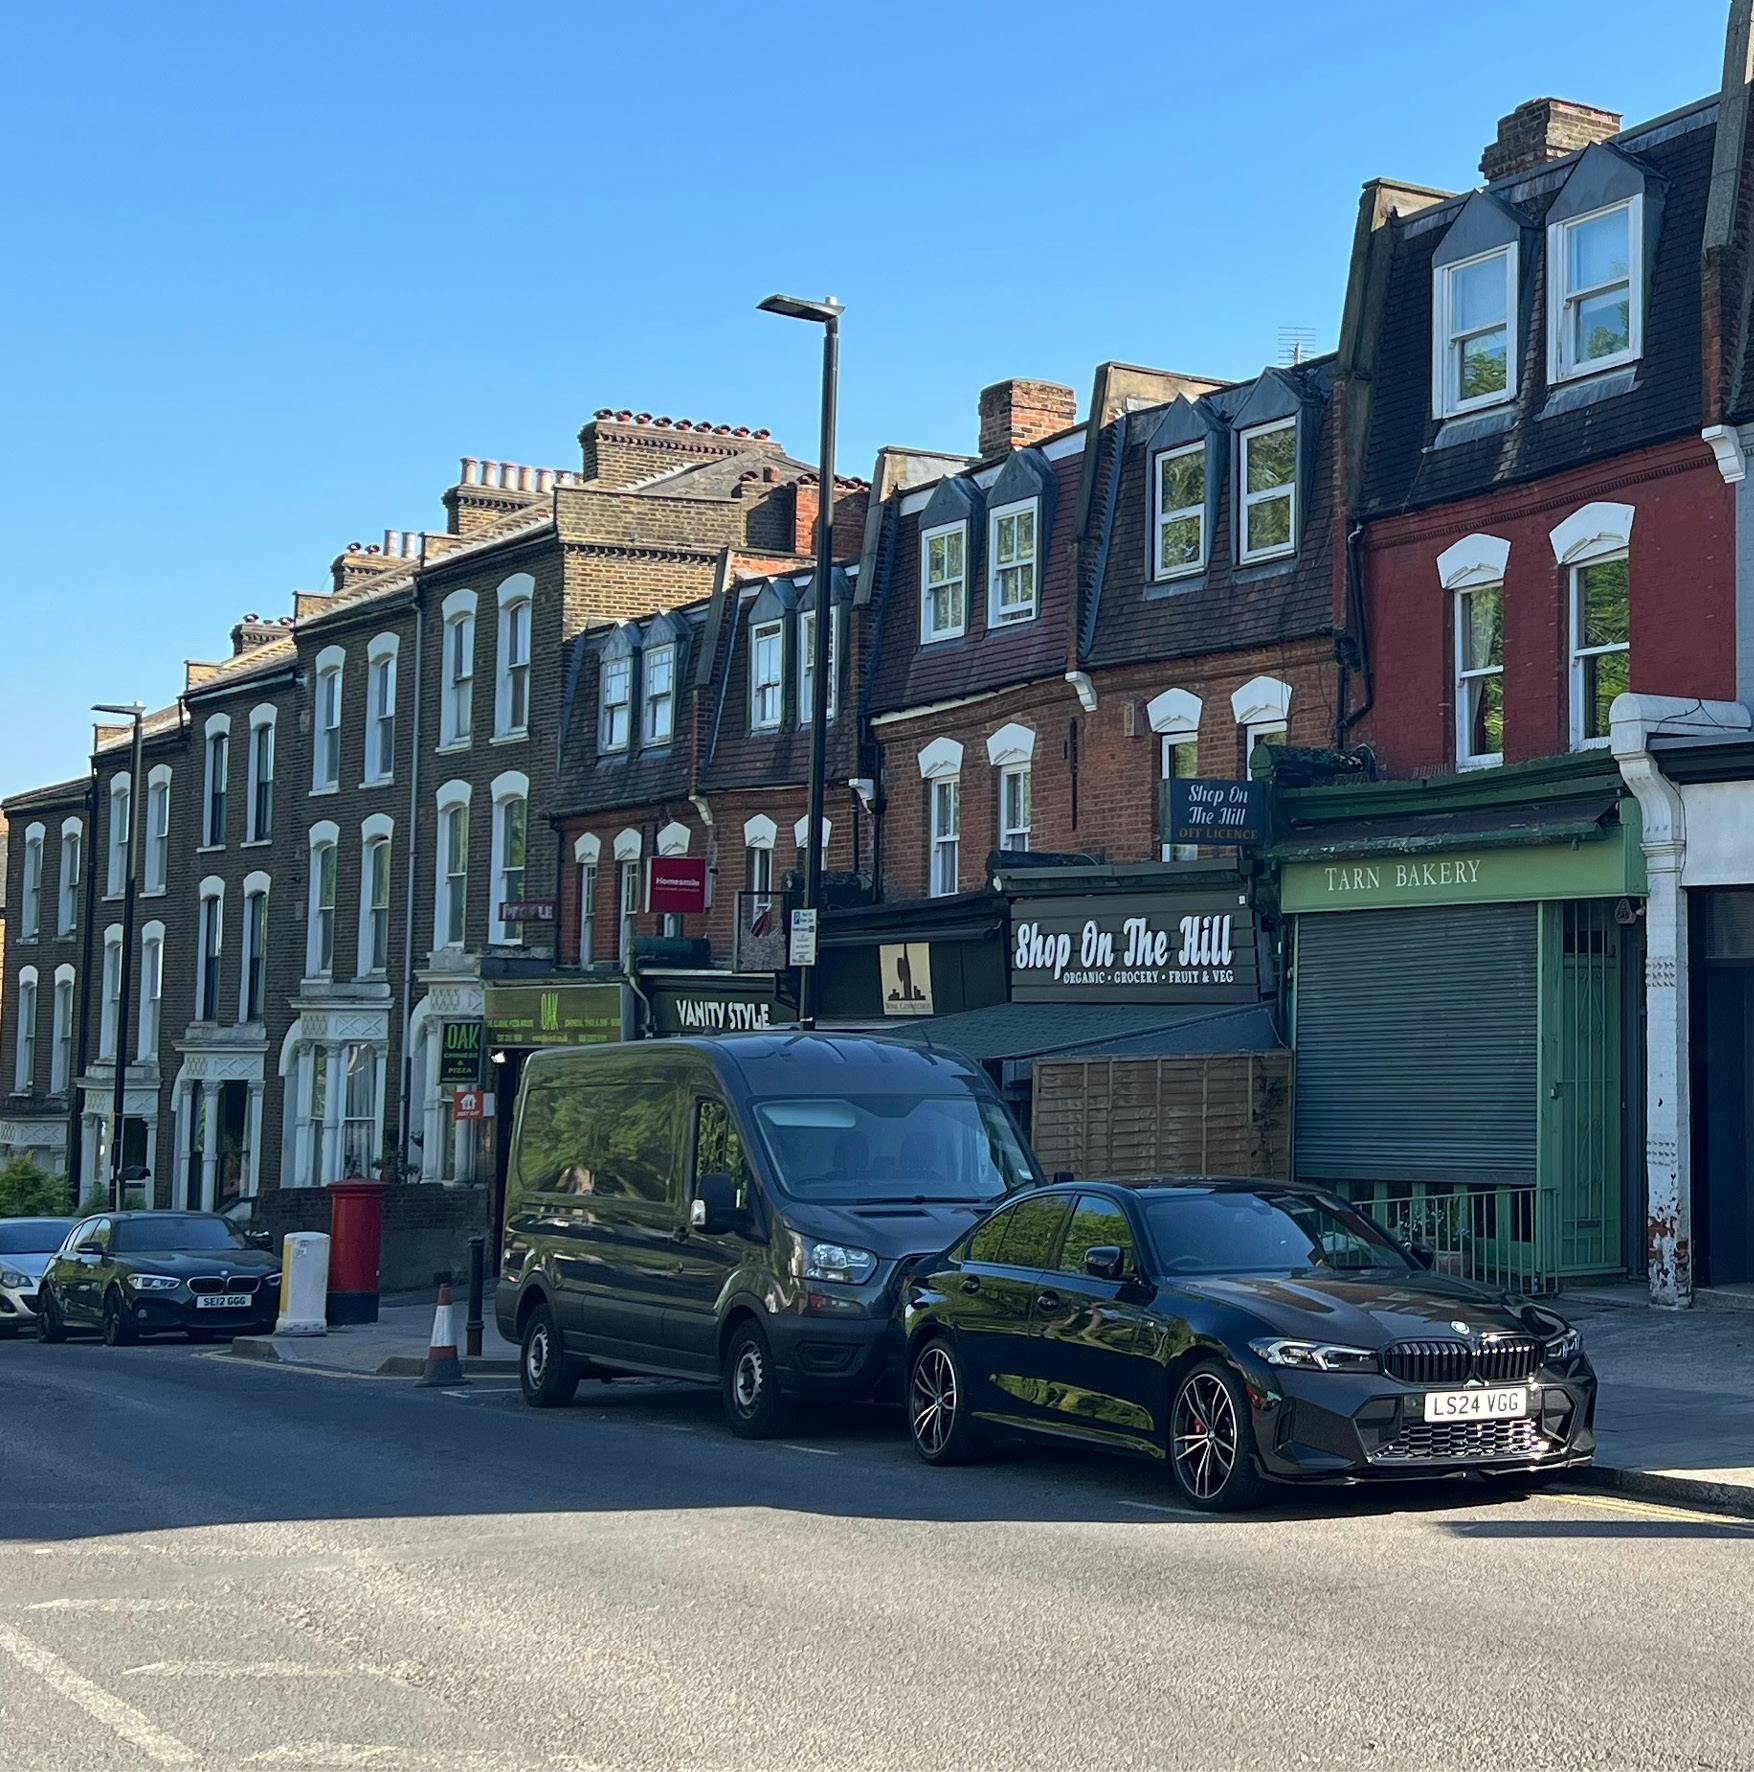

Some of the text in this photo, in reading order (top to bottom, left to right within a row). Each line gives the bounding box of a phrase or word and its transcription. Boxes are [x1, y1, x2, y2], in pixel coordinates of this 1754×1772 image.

[1188, 784, 1248, 806] Shop On
[1188, 806, 1246, 826] The Hill
[1179, 828, 1258, 840] OFF LICENCE
[656, 876, 700, 888] Homesmile
[1324, 859, 1481, 892] TARN BAKERY
[1015, 914, 1233, 980] Shop On The Hill
[1063, 970, 1234, 984] ORGANIC GROCERY FRUIT & VEG
[676, 999, 770, 1030] VANITY STYLE
[447, 1023, 481, 1050] OAK
[204, 1297, 226, 1306] SE12
[1434, 1392, 1518, 1416] LS24 VGG
